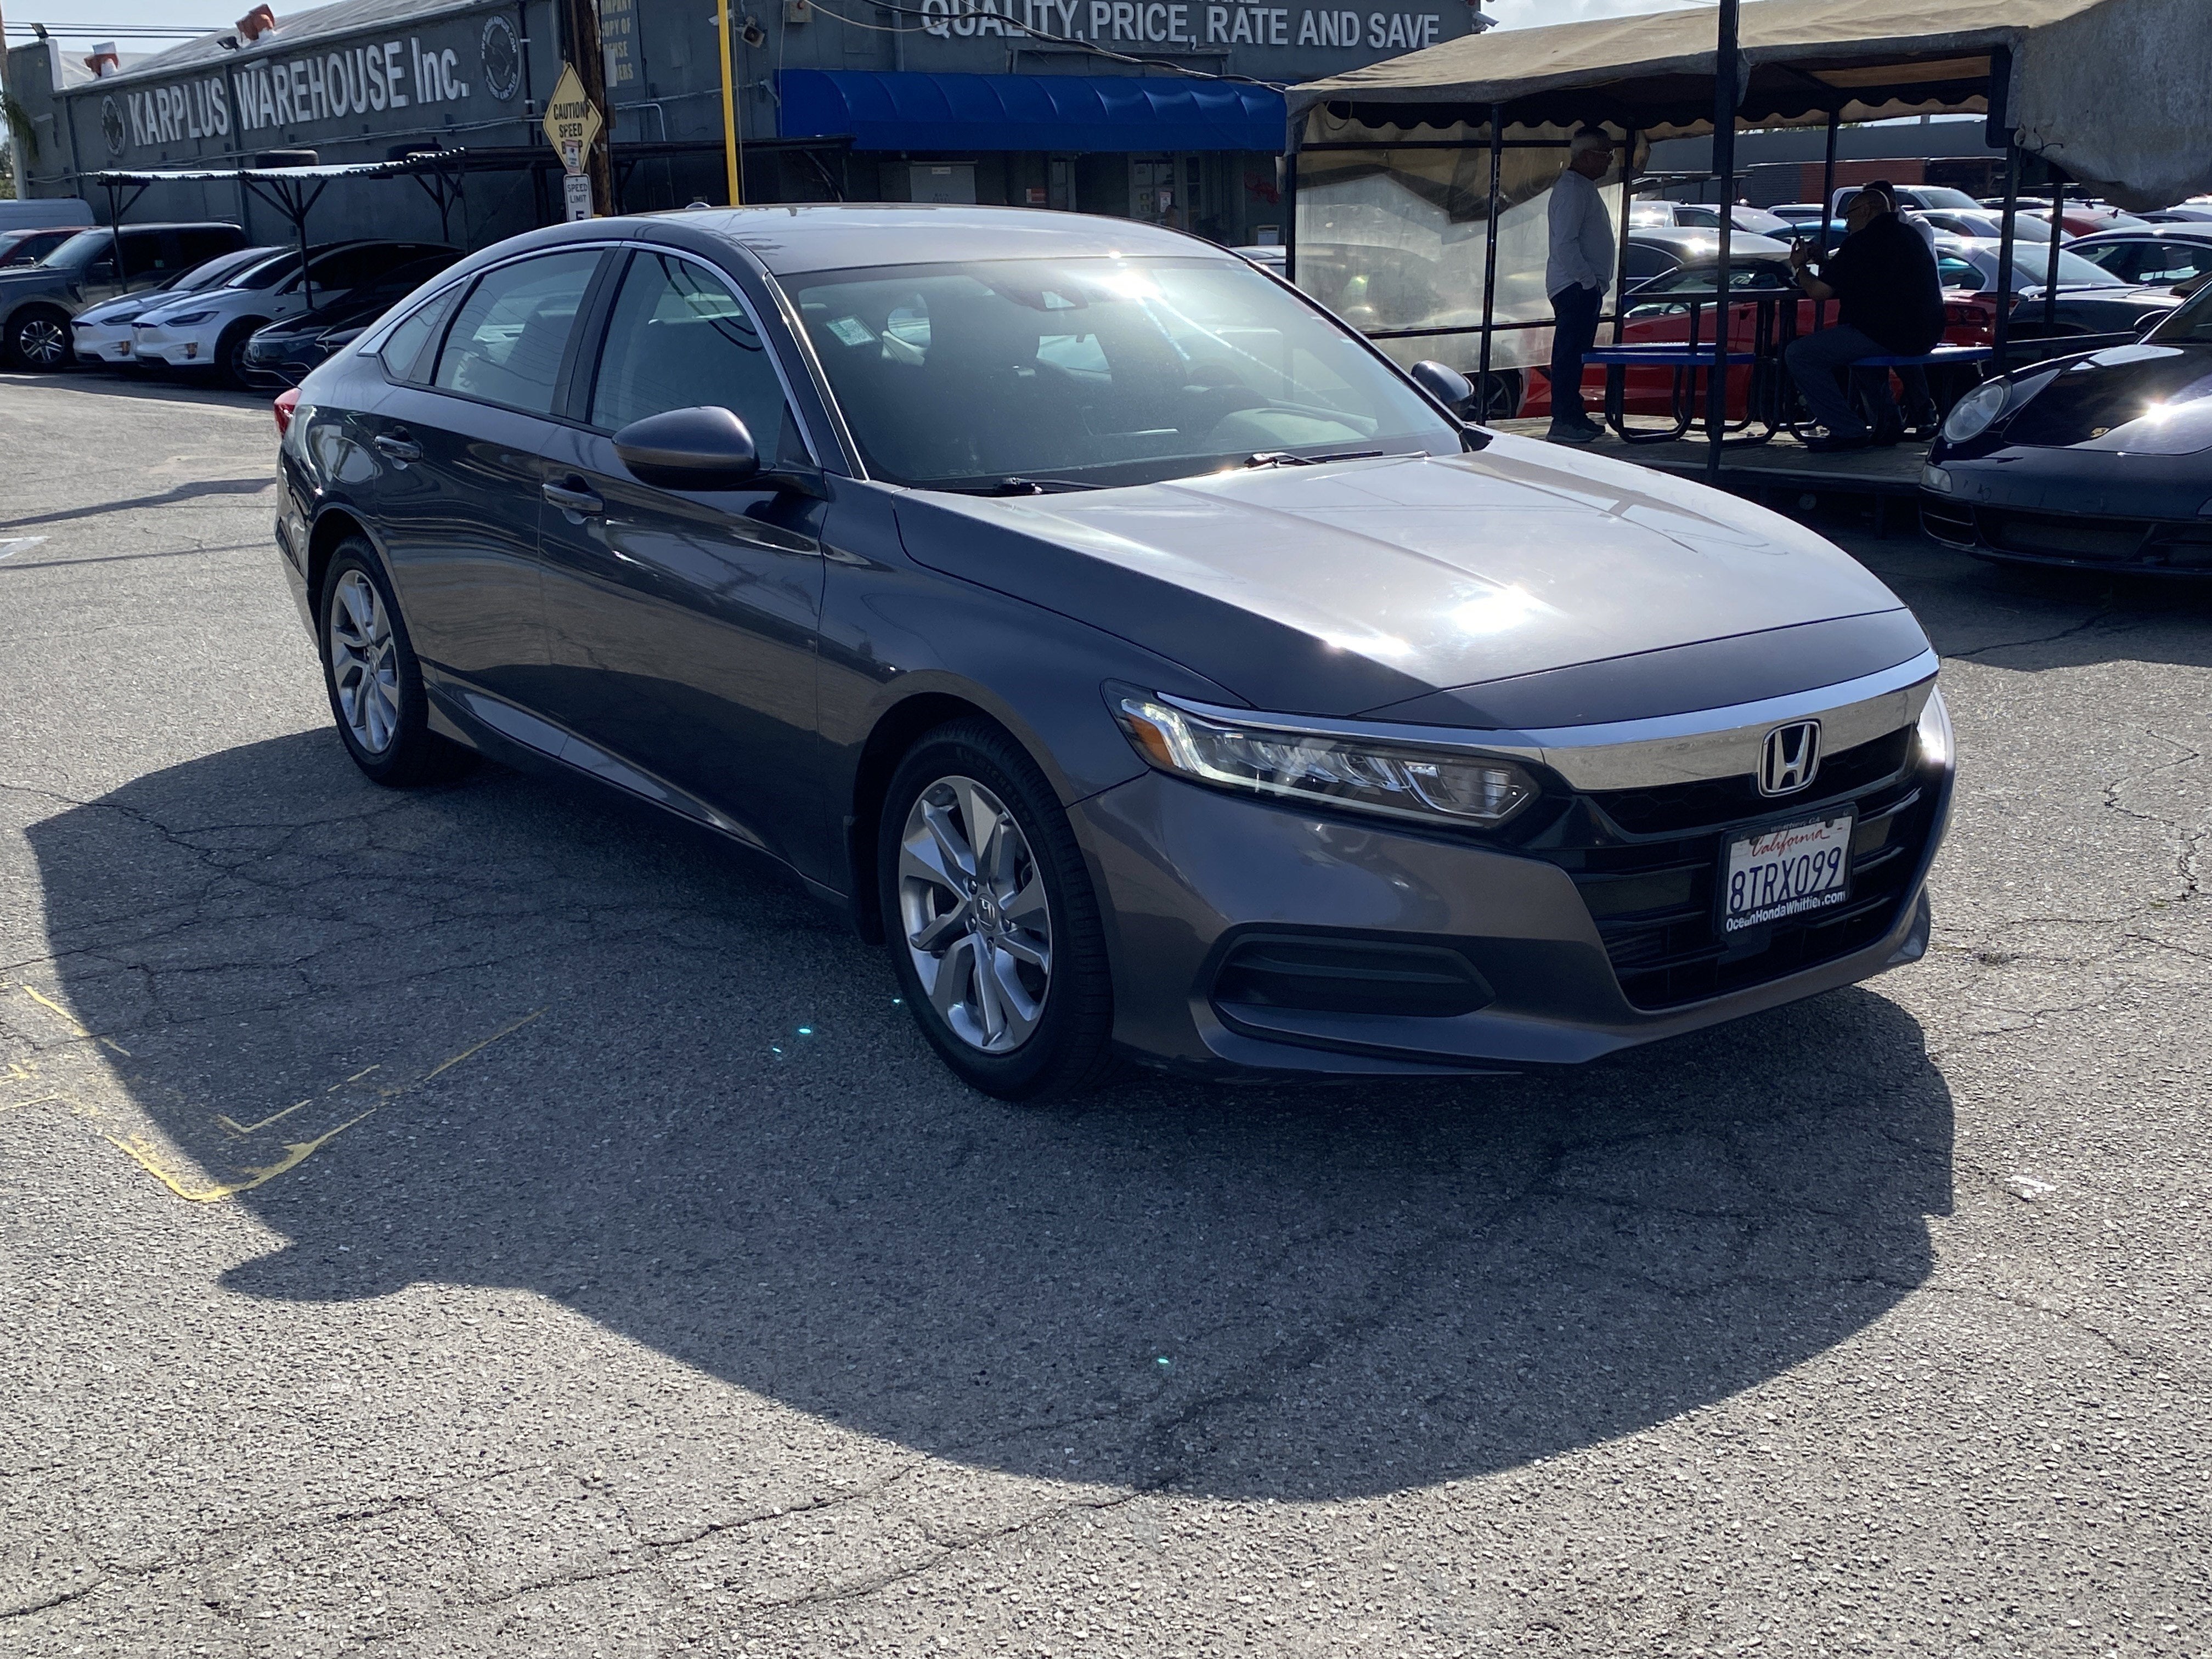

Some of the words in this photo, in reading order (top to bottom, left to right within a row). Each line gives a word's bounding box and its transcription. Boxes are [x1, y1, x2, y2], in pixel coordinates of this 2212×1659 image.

[601, 0, 631, 15] OMPANY
[1206, 5, 1288, 45] RATE
[1296, 9, 1361, 47] AND
[1368, 12, 1440, 49] SAVE
[127, 77, 232, 147] KARPLUS
[233, 40, 410, 131] WAREHOUSE
[411, 36, 471, 104] Inc.
[553, 101, 586, 120] CAUTION
[558, 123, 583, 138] SPEED
[561, 139, 583, 154] BP
[567, 184, 588, 192] SPEED
[569, 194, 586, 204] LIMIT
[1751, 828, 1831, 857] California
[1730, 846, 1842, 913] 8TRX099
[1726, 890, 1846, 933] OceanHondaWhittier.com
